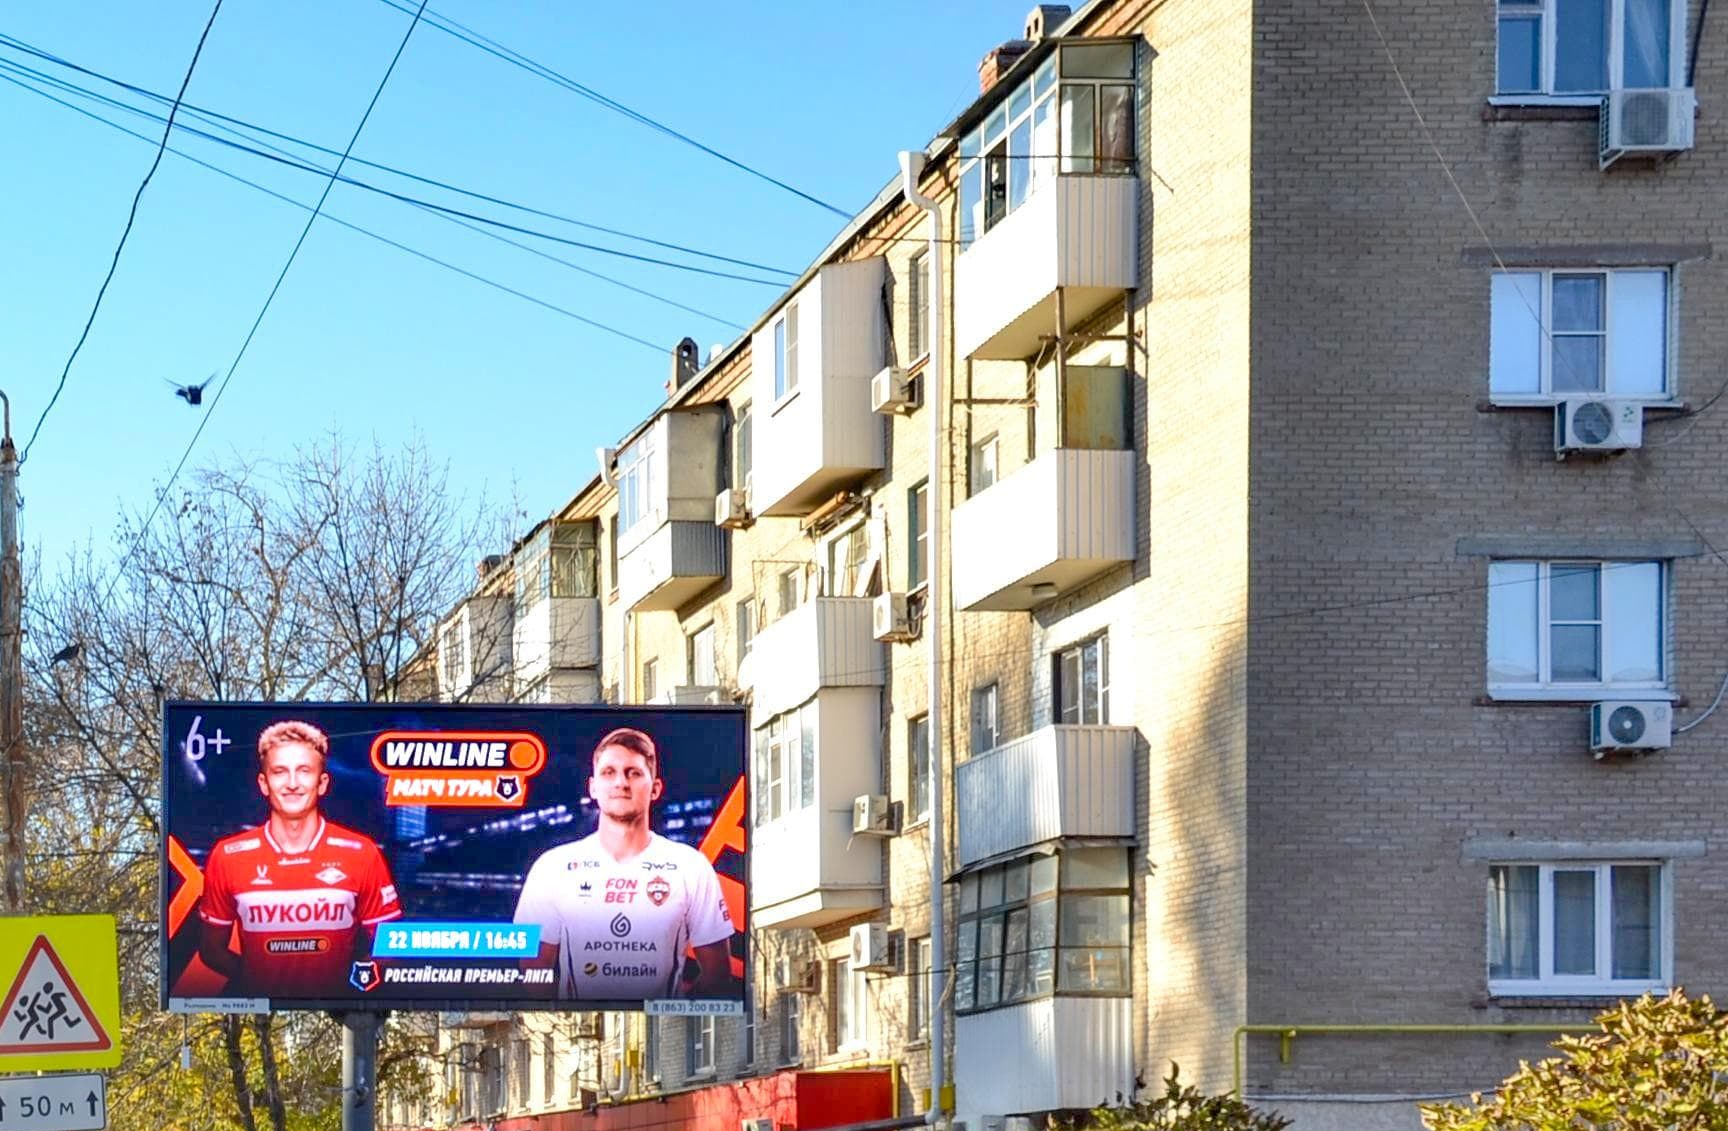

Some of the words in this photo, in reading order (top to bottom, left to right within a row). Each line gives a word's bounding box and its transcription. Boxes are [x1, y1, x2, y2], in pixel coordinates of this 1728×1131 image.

[186, 715, 231, 761] 6+
[386, 742, 507, 767] WINLINE
[392, 778, 445, 797] МАТЧ
[447, 778, 493, 797] ТУРА
[605, 878, 638, 889] FON
[604, 891, 639, 904] BET
[248, 898, 345, 923] ЛУКОЙЛ
[270, 940, 316, 951] WINLINE
[388, 930, 408, 949] 22
[411, 930, 470, 949] НОЯБРЯ
[473, 930, 481, 950] /
[485, 930, 527, 950] 16:45
[584, 941, 657, 951] APOTHEKA
[384, 965, 461, 983] РОССИЙСКАЯ
[465, 969, 554, 984] ПРЕМЬЕР-ЛИГА
[602, 962, 657, 977] билайн
[21, 1096, 51, 1117] 50
